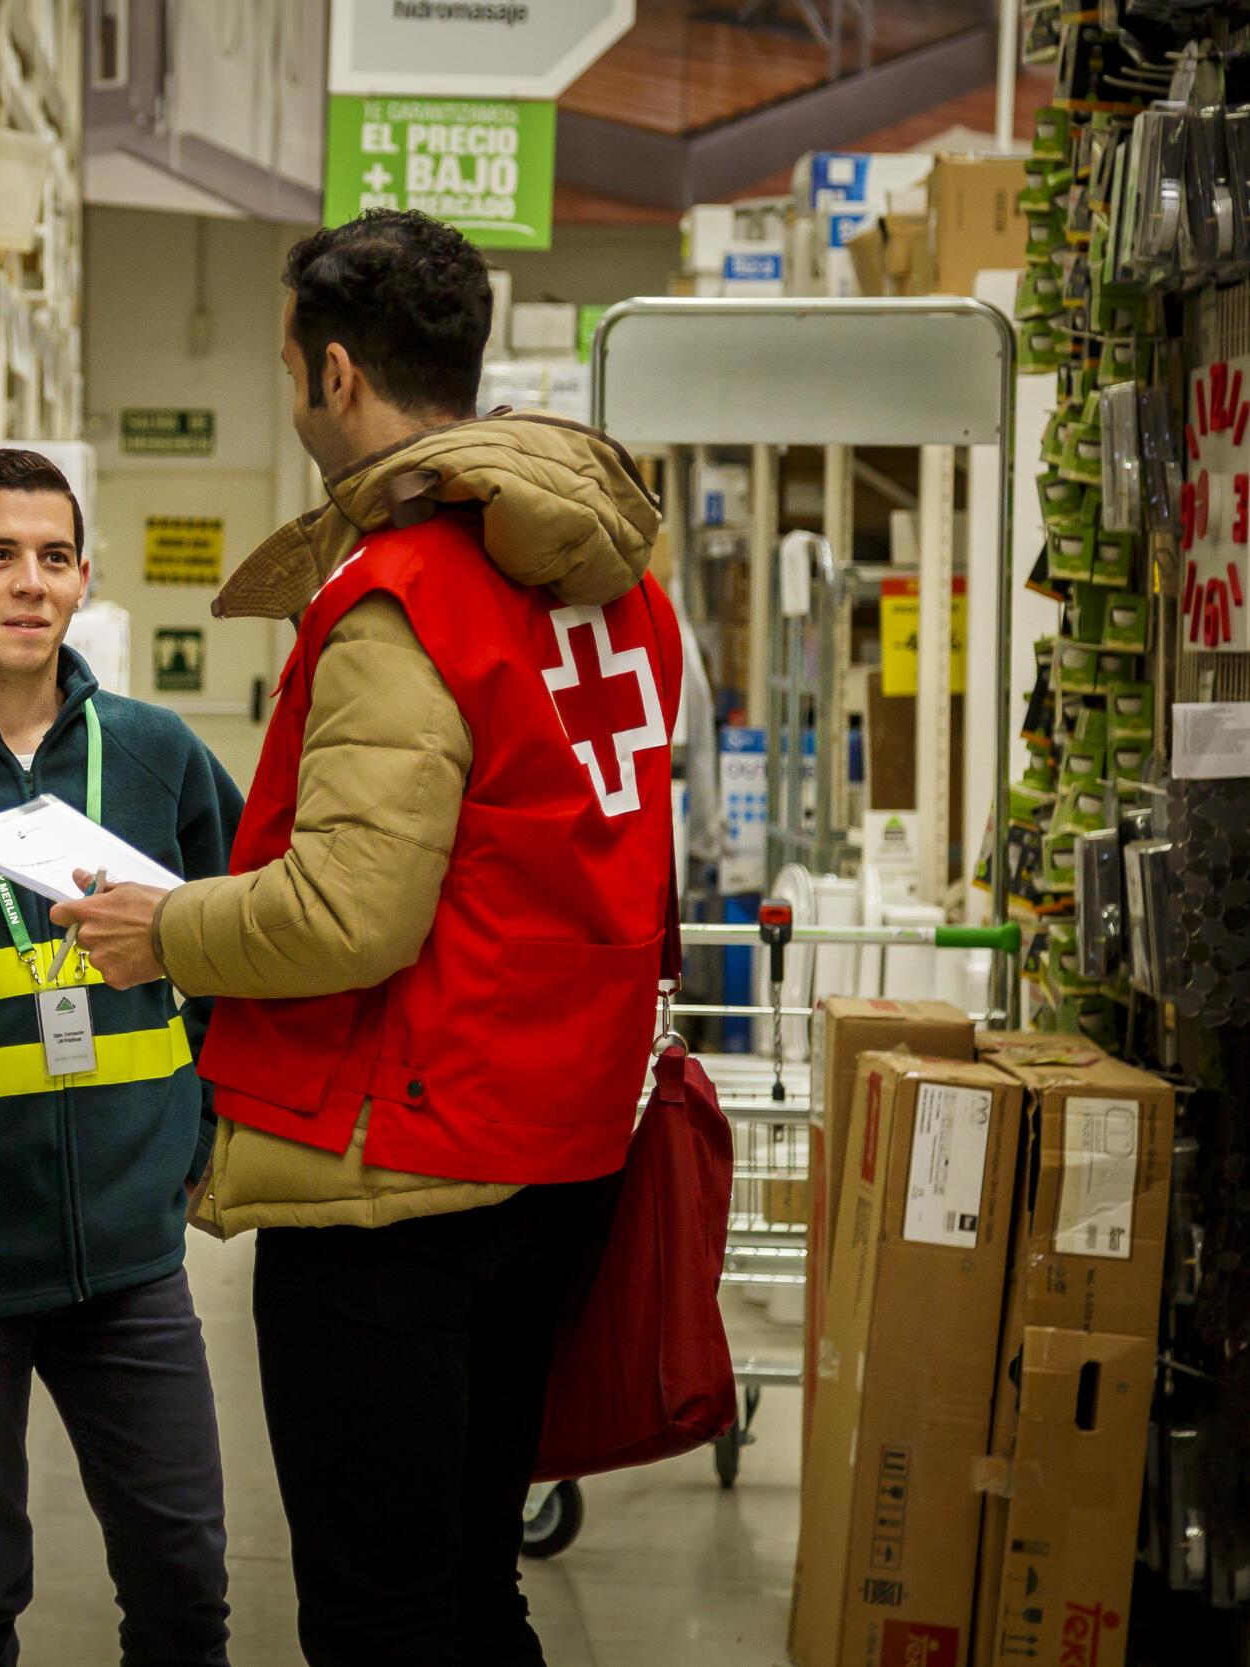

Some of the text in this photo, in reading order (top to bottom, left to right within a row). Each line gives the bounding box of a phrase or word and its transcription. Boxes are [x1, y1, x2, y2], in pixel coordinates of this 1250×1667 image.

[392, 0, 528, 27] hidromasaje
[361, 122, 518, 155] EL PRECIO
[405, 155, 518, 195] BAJO
[1232, 473, 1249, 544] 3
[1060, 1601, 1121, 1667] Tek
